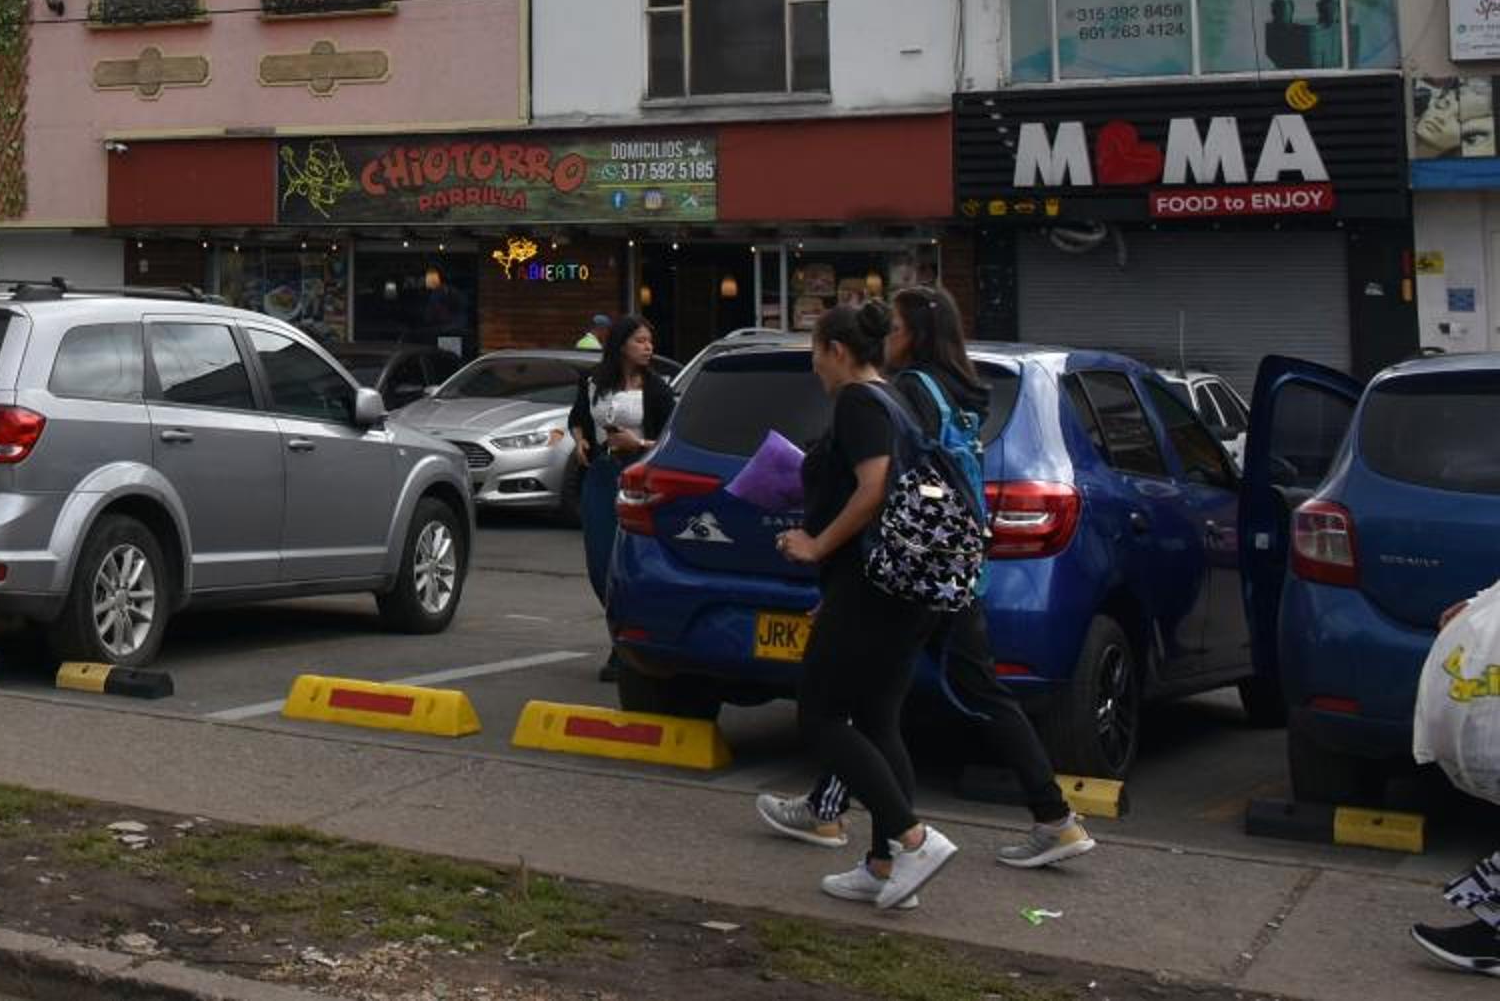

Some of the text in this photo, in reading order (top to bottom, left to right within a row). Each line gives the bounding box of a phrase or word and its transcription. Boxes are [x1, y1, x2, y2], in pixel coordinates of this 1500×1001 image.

[611, 141, 683, 159] DOMICILIOS
[621, 162, 646, 179] 317
[1156, 190, 1323, 212] FOOD to ENJOY
